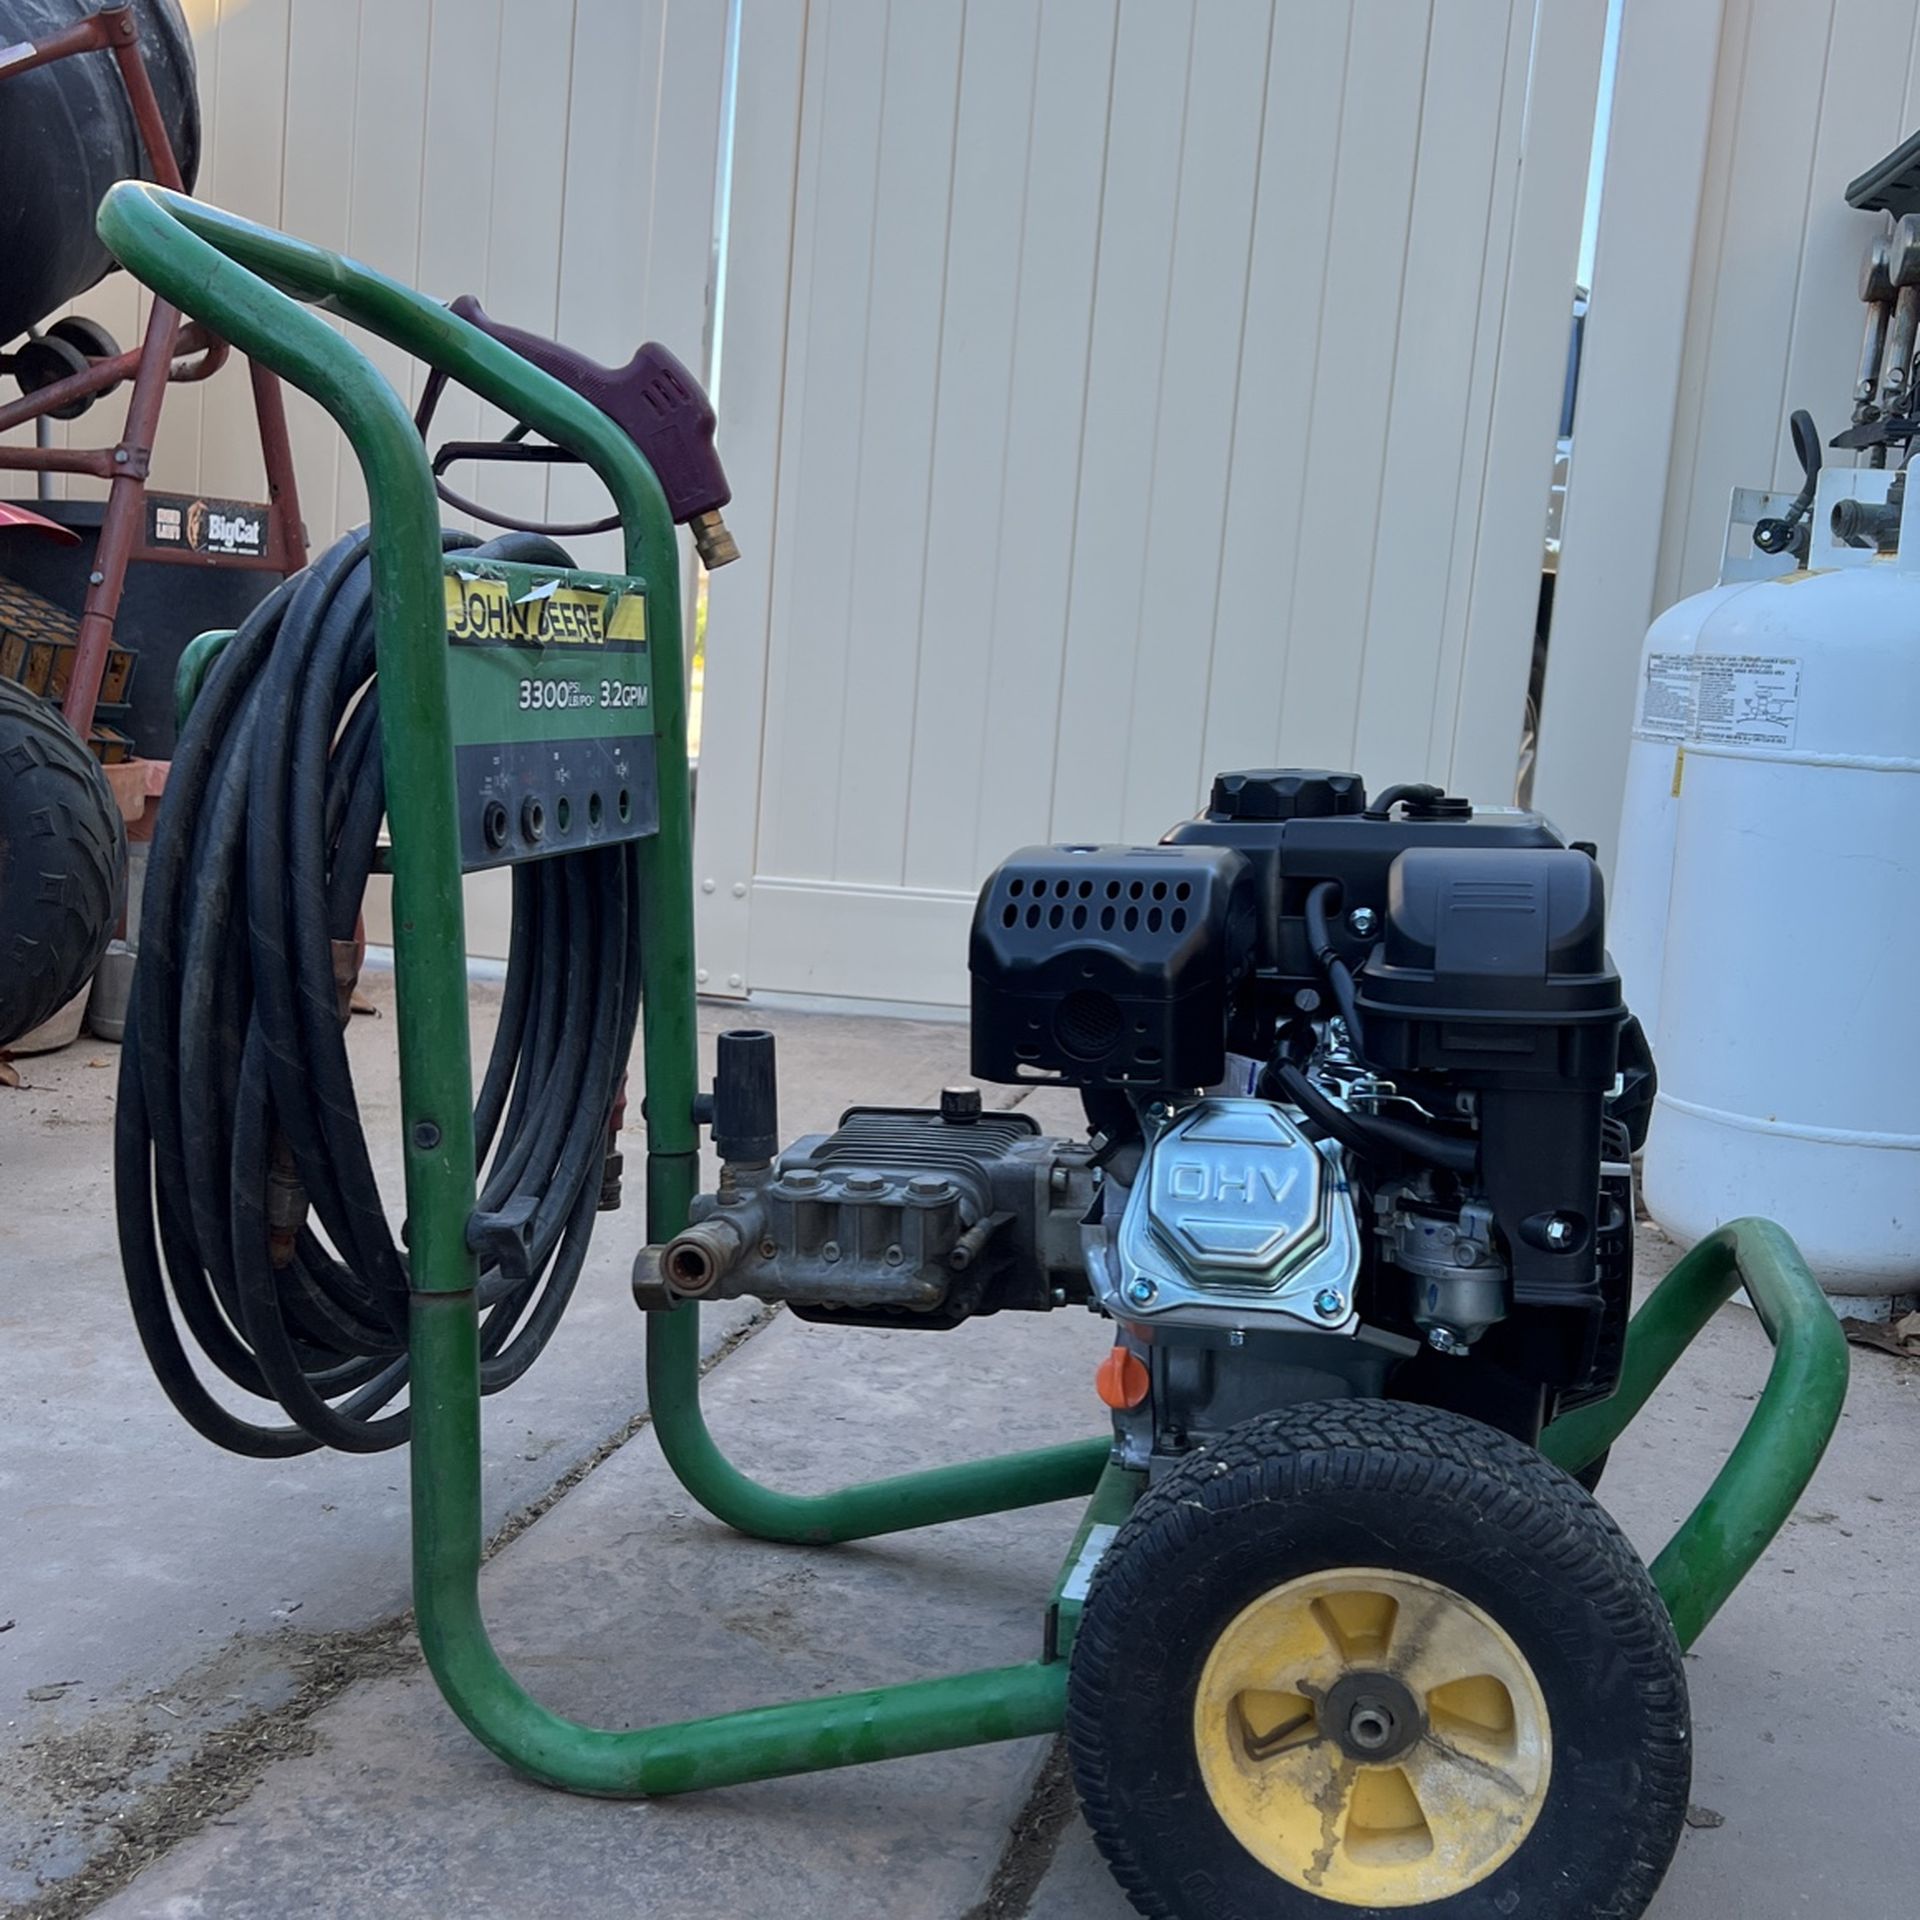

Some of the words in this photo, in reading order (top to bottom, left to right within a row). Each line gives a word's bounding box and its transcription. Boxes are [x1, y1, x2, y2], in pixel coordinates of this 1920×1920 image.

[208, 514, 260, 547] BigCat
[455, 583, 530, 637] JOHN
[538, 598, 602, 639] DEERE
[519, 680, 568, 709] 3300
[1168, 1161, 1298, 1203] OHV
